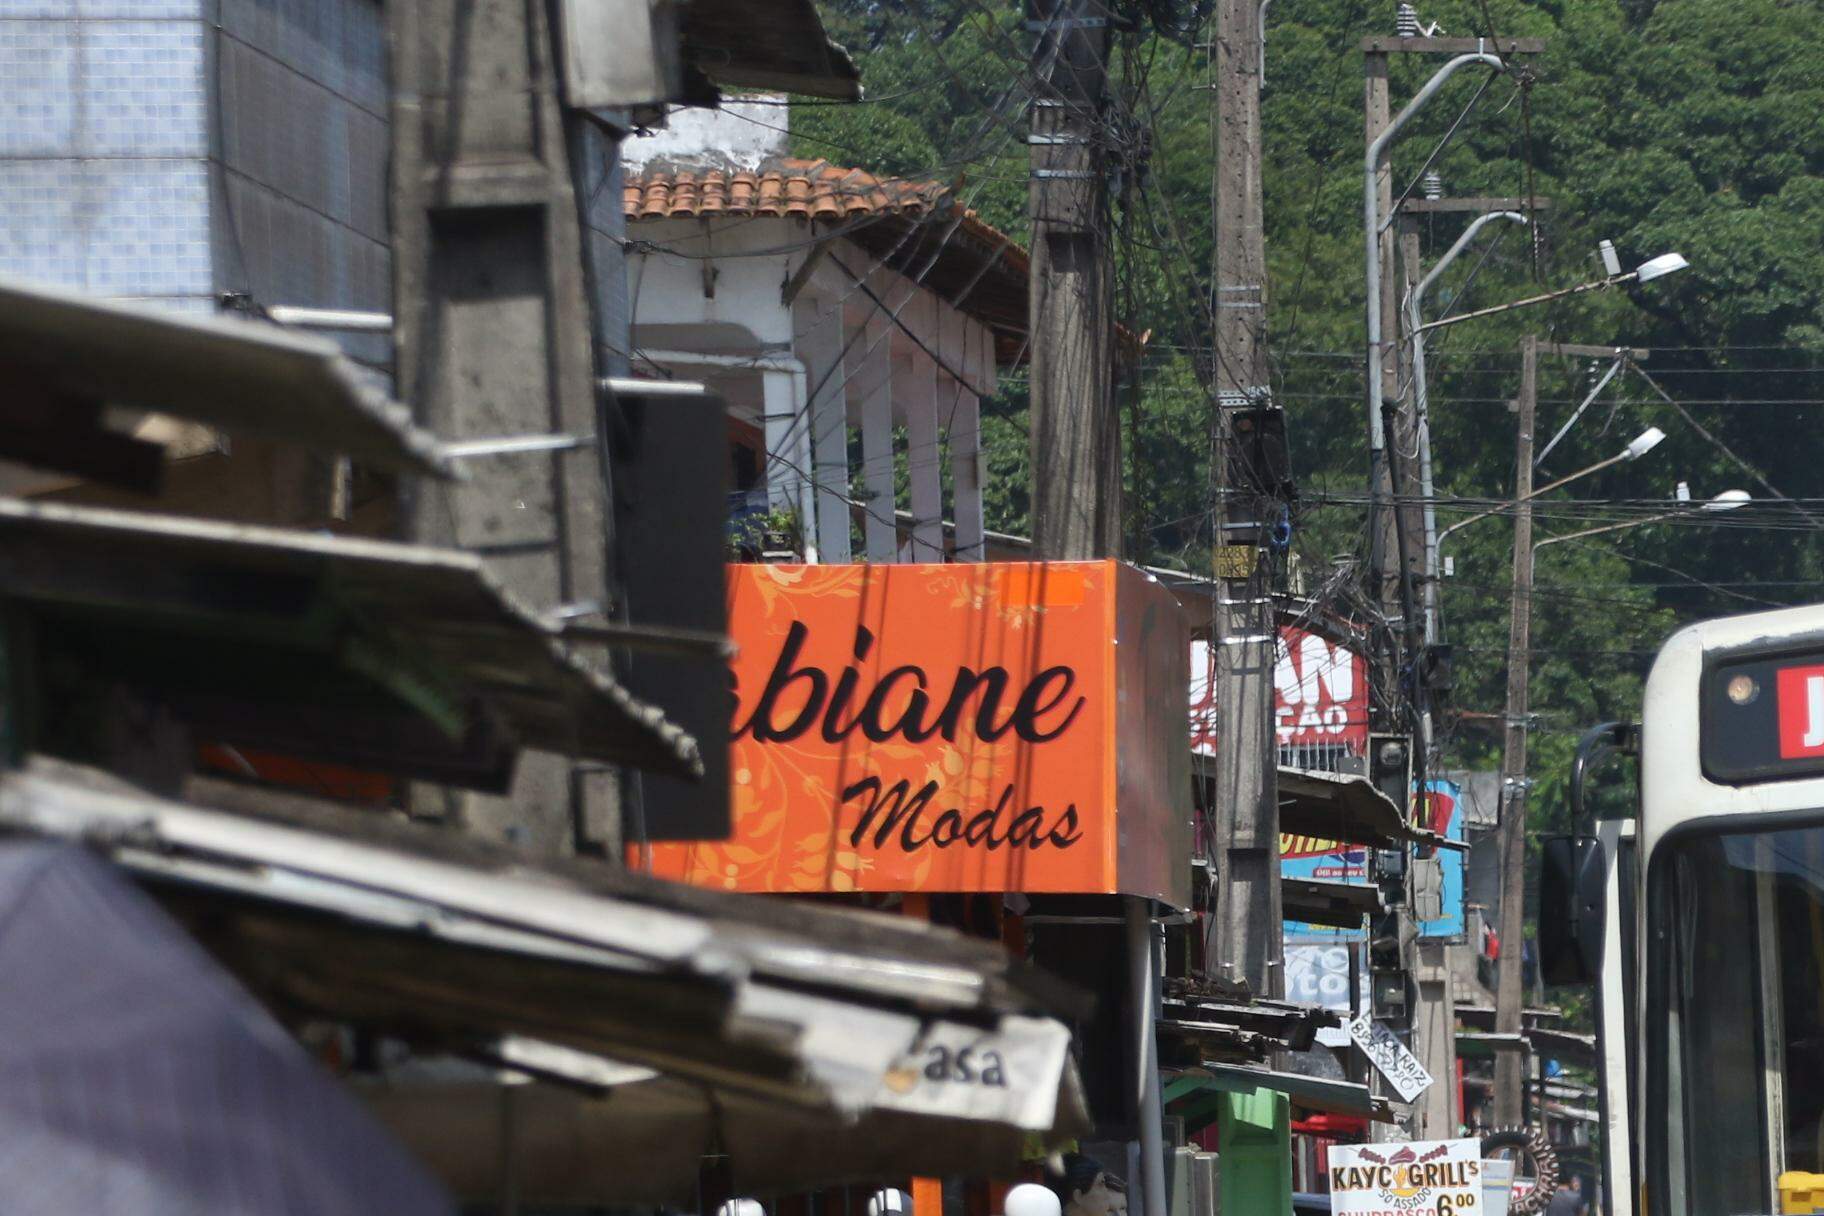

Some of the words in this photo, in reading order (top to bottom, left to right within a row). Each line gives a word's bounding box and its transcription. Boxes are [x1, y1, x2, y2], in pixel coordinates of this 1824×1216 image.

[730, 620, 1086, 744] biane
[841, 775, 1083, 852] Modas
[1332, 1165, 1393, 1191] KAYC
[1393, 1187, 1431, 1210] ASSADO
